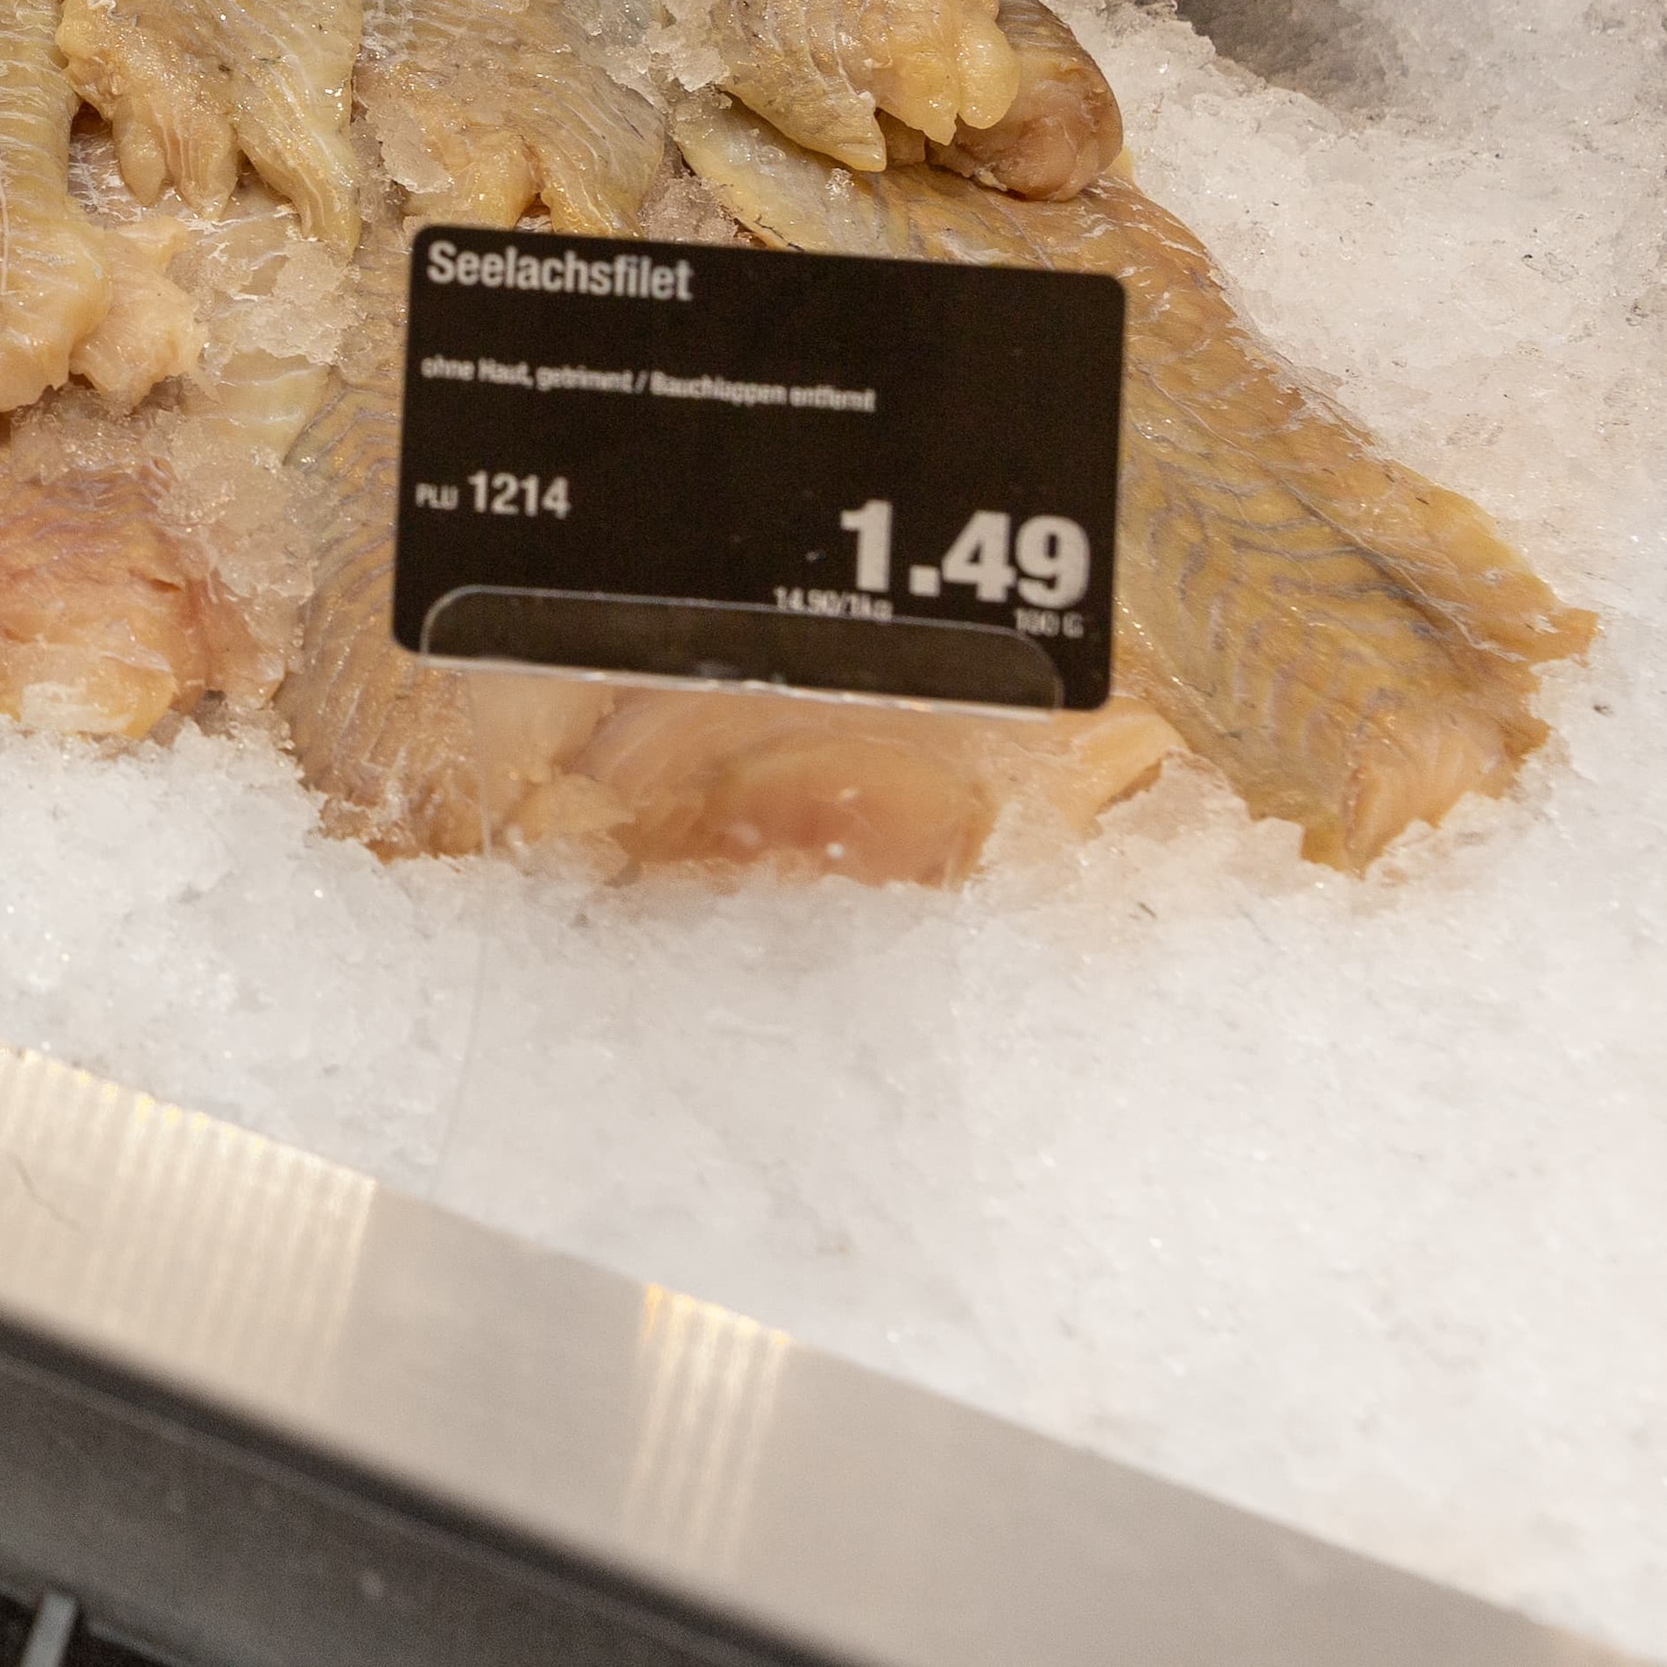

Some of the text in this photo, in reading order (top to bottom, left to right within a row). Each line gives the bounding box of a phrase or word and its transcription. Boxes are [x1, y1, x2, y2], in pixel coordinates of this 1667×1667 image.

[427, 241, 694, 301] Seelachsfilet
[421, 353, 475, 381] ohne
[416, 471, 571, 519] PLU 1214
[840, 498, 1091, 610] 1.49
